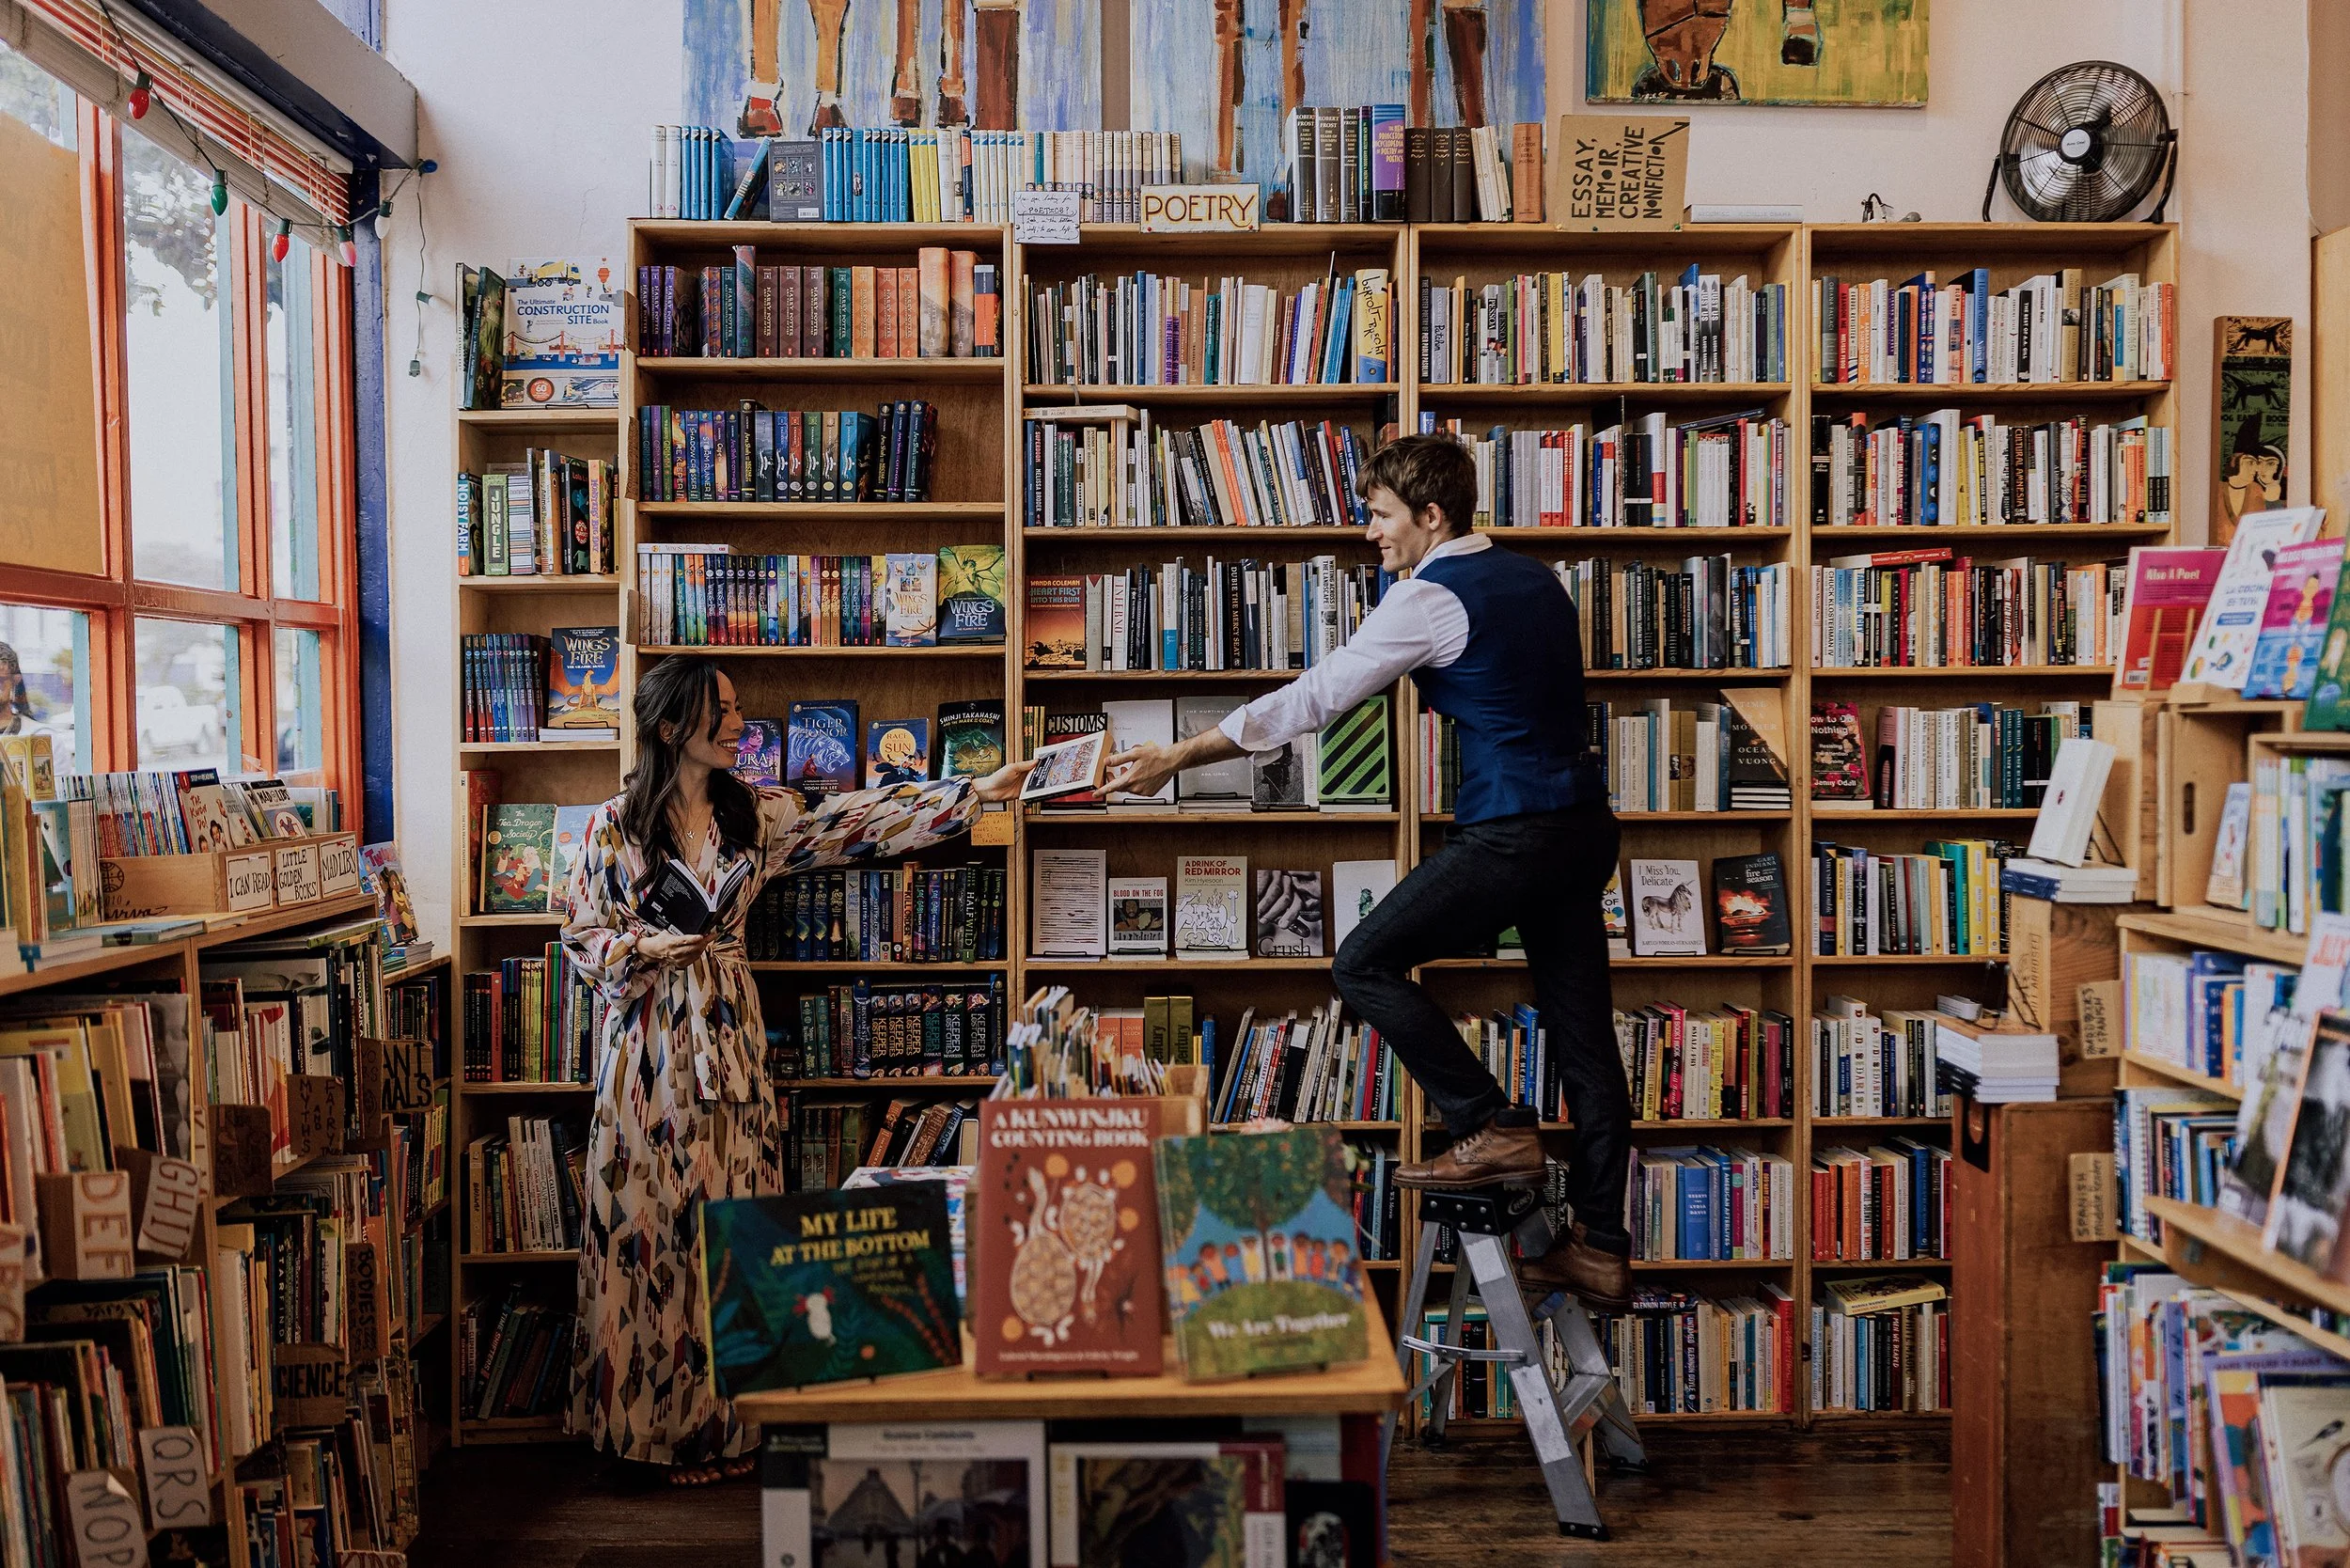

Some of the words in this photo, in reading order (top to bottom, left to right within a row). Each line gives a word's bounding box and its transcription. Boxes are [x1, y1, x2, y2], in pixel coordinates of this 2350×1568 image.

[1572, 138, 1597, 218] ESSAY,
[1595, 142, 1622, 218] MEMOIR,
[1619, 126, 1644, 218] CREATIVE
[1145, 195, 1256, 227] POETRY
[517, 305, 609, 316] CONSTRUCTION
[567, 315, 592, 325] SITE
[1488, 299, 1496, 329] PESSOA
[1701, 312, 1708, 321] US
[1498, 312, 1507, 342] PESSOA
[2014, 429, 2025, 467] CULTURAL
[2014, 468, 2025, 508] AMNESIA
[458, 484, 469, 519] NOISY
[491, 490, 501, 558] JUNGLE
[458, 522, 469, 552] FARM
[590, 537, 600, 553] DAY
[1231, 567, 1240, 591] DUBIE
[1856, 572, 1864, 595] FARGO
[2146, 568, 2166, 580] Also
[2177, 568, 2201, 580] Poet
[895, 592, 928, 604] WINGS
[1029, 588, 1055, 596] HEART
[1057, 588, 1081, 596] FIRST
[1231, 592, 1240, 609] THE
[900, 604, 923, 615] FIRE
[948, 599, 995, 614] WINGS
[1114, 584, 1124, 634] INFERNO
[1856, 596, 1864, 616] ROCK
[954, 613, 988, 628] FIRE
[1231, 611, 1240, 635] MERCY
[1856, 617, 1864, 634] CITY
[562, 635, 611, 651] WINGS
[1231, 637, 1241, 656] SEAT
[571, 651, 603, 665] FIRE
[802, 717, 844, 729] TIGER
[940, 714, 963, 724] SHINJI
[963, 713, 1001, 721] TAKAHASHI
[1047, 714, 1106, 732] CUSTOMS
[798, 727, 848, 739] HONOR
[1811, 726, 1848, 736] Nothing
[885, 743, 911, 752] SUN
[259, 790, 273, 803] MAD
[275, 788, 290, 801] LIBS
[512, 818, 543, 829] Dragon
[503, 831, 538, 840] Society
[282, 849, 307, 868] LITTLE
[321, 856, 339, 883] MAD
[338, 845, 356, 876] LIBS
[1746, 860, 1777, 869] INDIANA
[278, 867, 304, 889] GOLDEN
[1185, 868, 1202, 876] RED
[1204, 868, 1242, 876] MIRROR
[1646, 865, 1664, 876] Miss
[1746, 869, 1761, 877] fire
[1747, 875, 1774, 884] season
[1825, 857, 1834, 886] Ancestor
[235, 875, 252, 896] CAN
[253, 870, 271, 891] READ
[1641, 876, 1674, 886] Delicate
[294, 882, 318, 901] BOOKS
[903, 891, 912, 908] KILL
[1825, 887, 1834, 914] Trouble
[903, 909, 912, 936] ORDER
[1258, 937, 1311, 956] Crush
[912, 1015, 921, 1054] KEEPER
[383, 1043, 423, 1078] ANI
[381, 1073, 432, 1111] MALS
[300, 1078, 313, 1153] MYTHS
[995, 1112, 1008, 1128] A
[991, 1129, 1092, 1148] COUNTING
[1093, 1129, 1150, 1148] BOOK
[800, 1211, 838, 1238] MY
[845, 1206, 898, 1232] LIFE
[770, 1244, 797, 1266] AT
[800, 1239, 842, 1262] THE
[845, 1229, 931, 1258] BOTTOM
[1685, 1317, 1695, 1343] UNTAMED
[1891, 1331, 1899, 1341] WE
[276, 1360, 345, 1399] CIENCE
